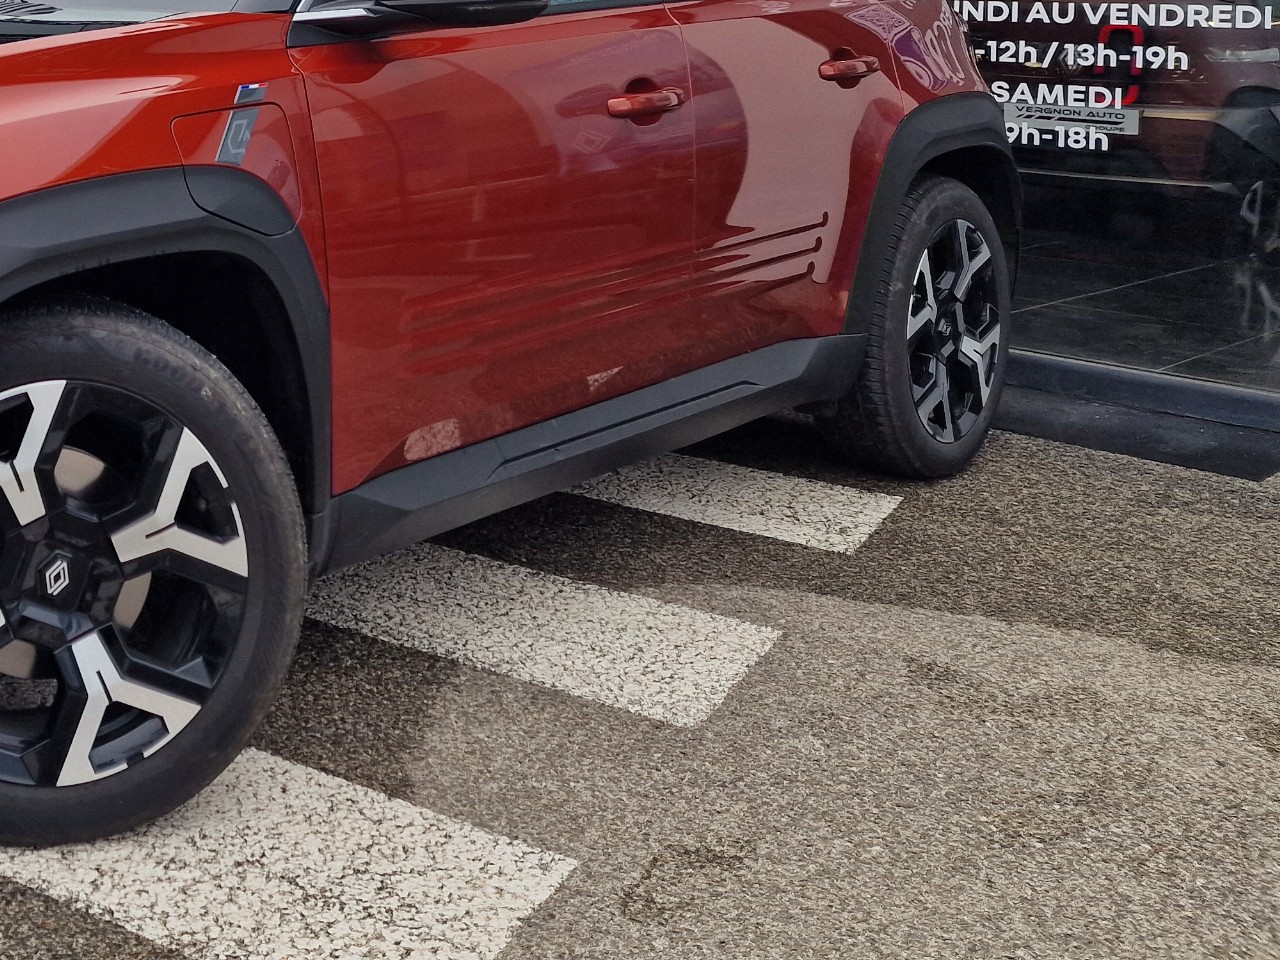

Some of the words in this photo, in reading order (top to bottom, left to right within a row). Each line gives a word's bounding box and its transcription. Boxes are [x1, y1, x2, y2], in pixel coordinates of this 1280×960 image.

[1026, 3, 1075, 24] AU
[1083, 2, 1272, 30] VENDREDI
[1064, 43, 1189, 71] 13h-19h
[991, 81, 1122, 110] SAMEDI
[1016, 105, 1081, 117] VERGNON
[1086, 111, 1126, 120] AUTO
[1005, 122, 1109, 151] 9h-18h
